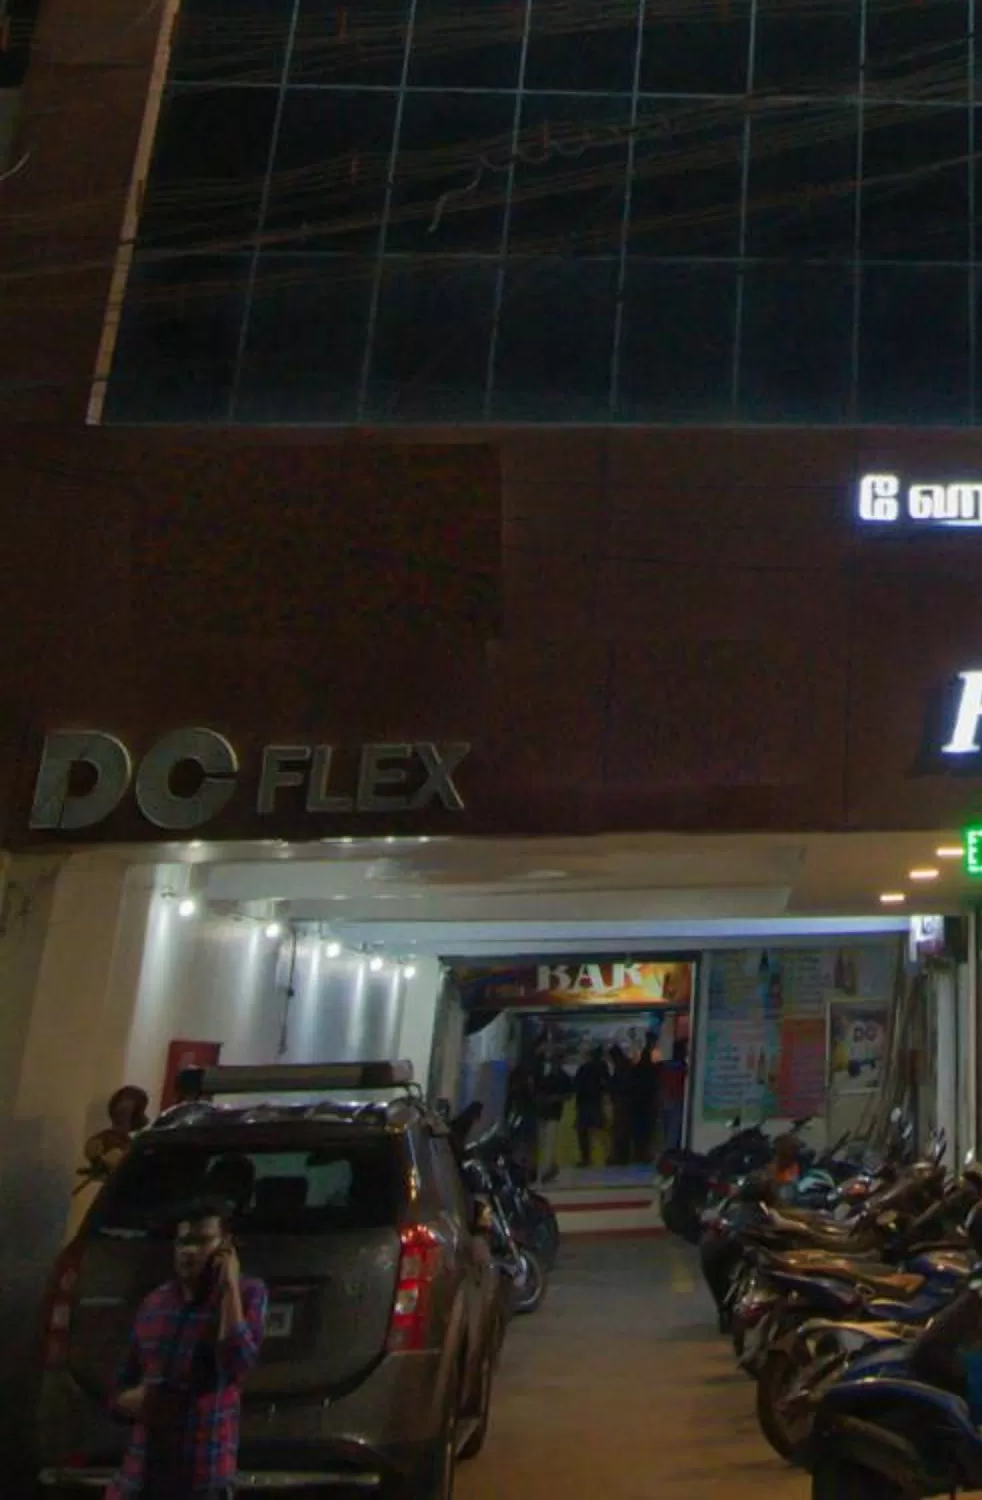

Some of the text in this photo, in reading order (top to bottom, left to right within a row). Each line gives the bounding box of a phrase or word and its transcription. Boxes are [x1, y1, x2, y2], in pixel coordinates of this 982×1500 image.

[29, 728, 471, 829] DC FLEX
[536, 963, 642, 994] BAR
